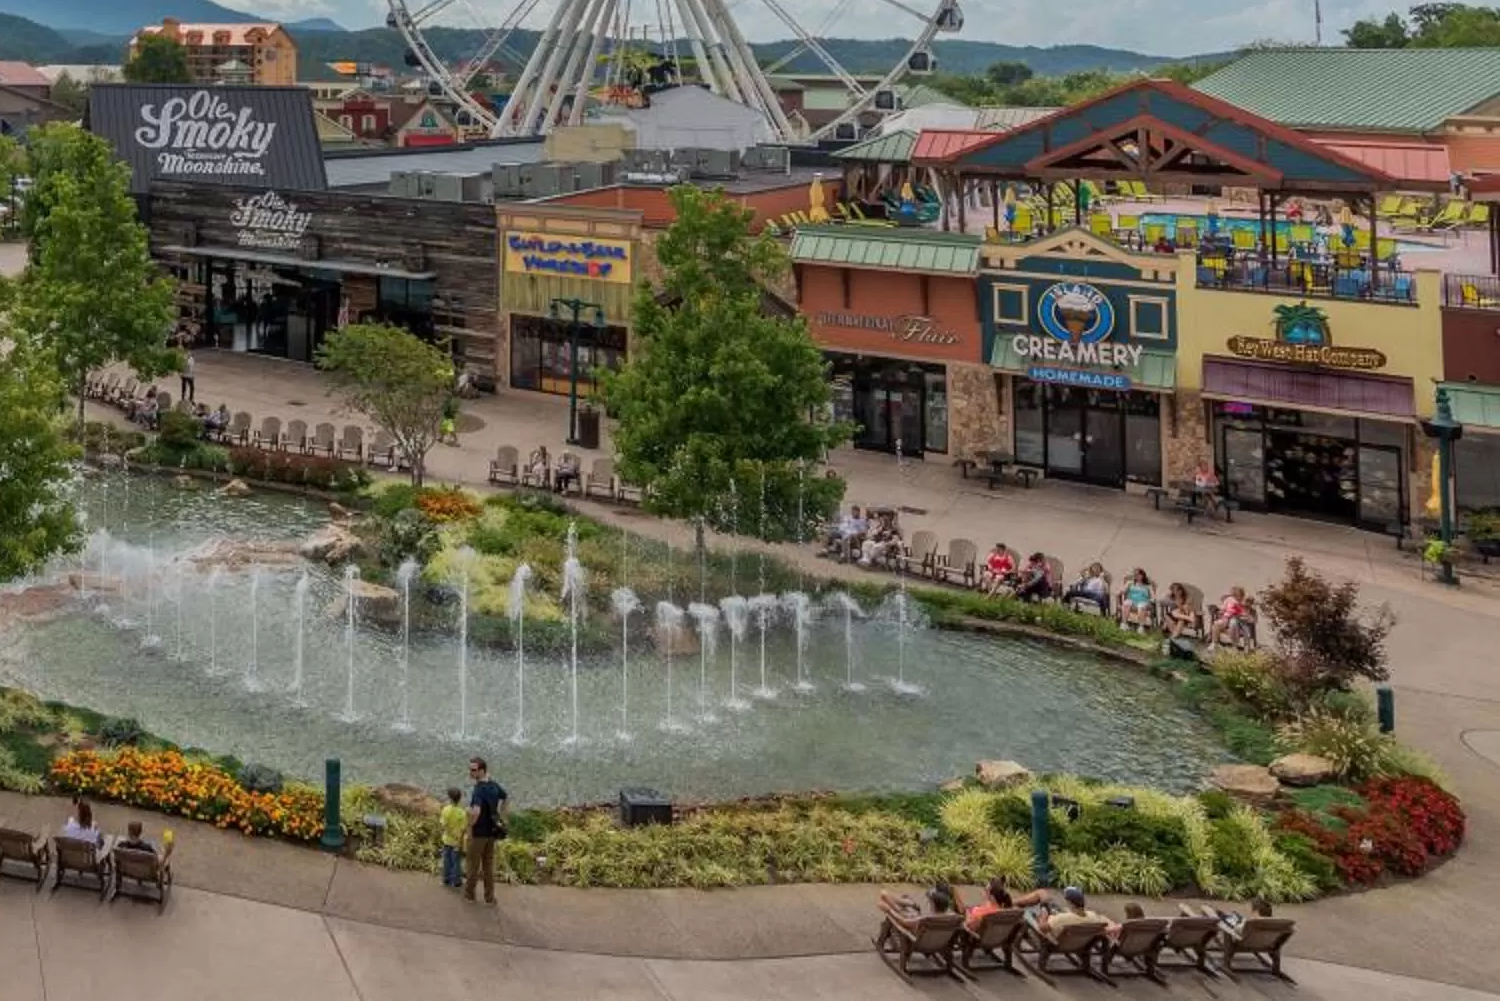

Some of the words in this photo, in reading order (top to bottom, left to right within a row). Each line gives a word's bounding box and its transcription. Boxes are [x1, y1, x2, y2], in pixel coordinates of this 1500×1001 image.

[188, 90, 237, 121] Ole
[135, 98, 276, 158] Smoky
[157, 152, 266, 175] Moonshine
[230, 195, 312, 238] Smoky
[1012, 334, 1143, 367] CREAMERY
[1237, 339, 1259, 357] Key
[1259, 340, 1292, 359] West
[1295, 345, 1319, 362] Hat
[1321, 346, 1382, 369] Company
[1032, 367, 1125, 388] HOMEMADE
